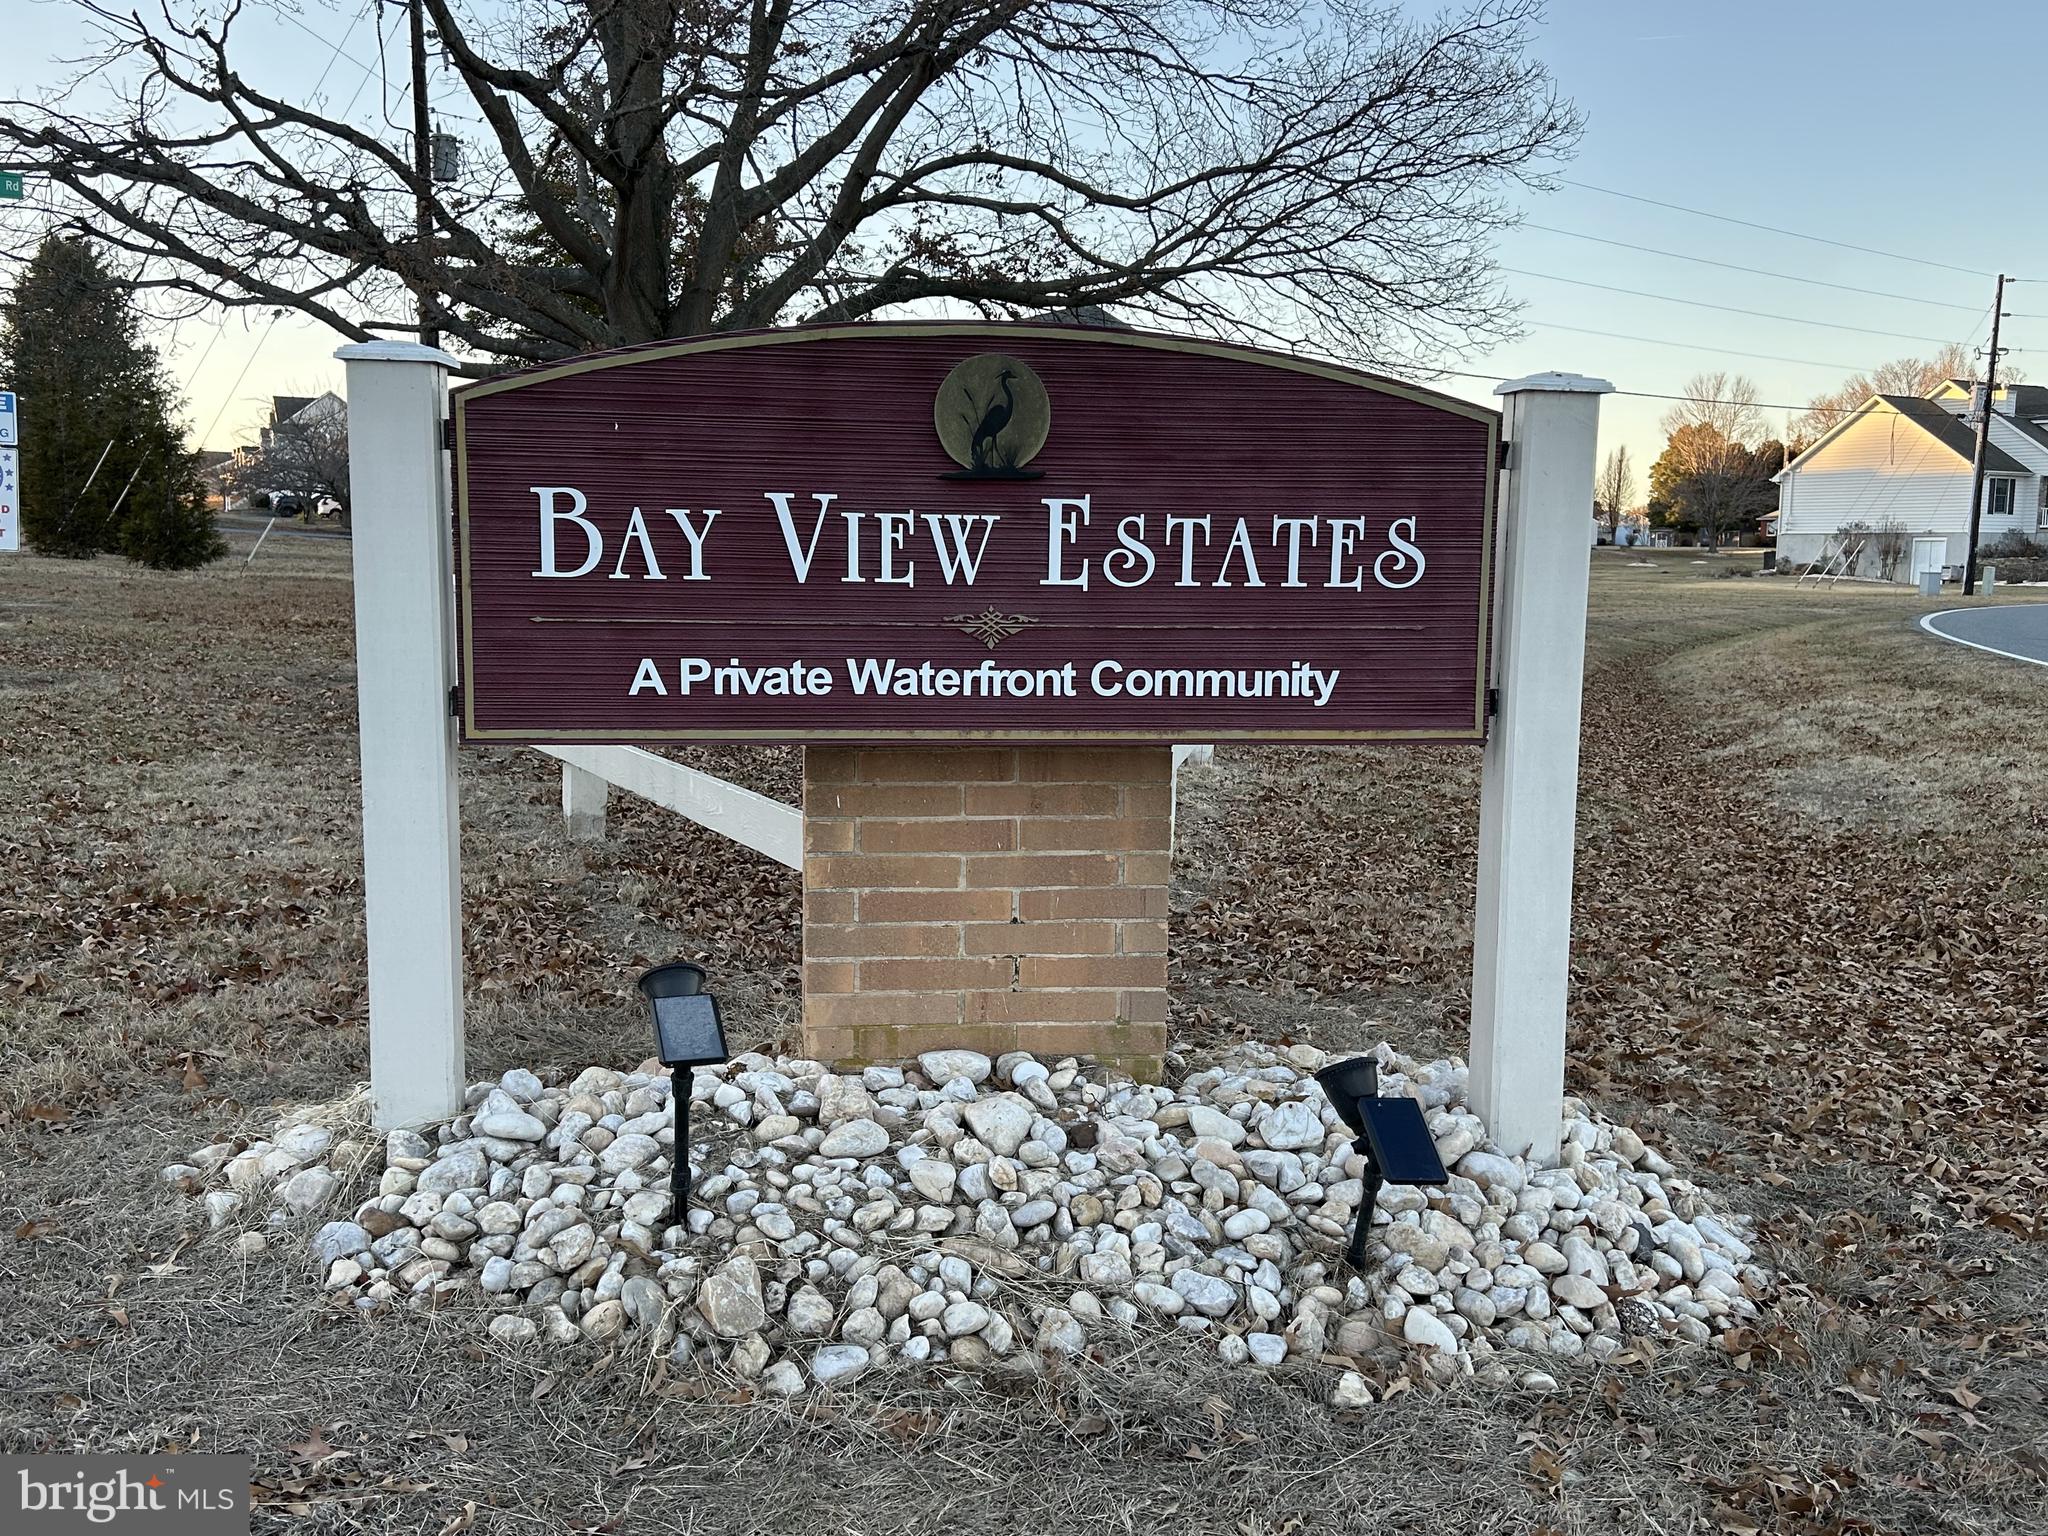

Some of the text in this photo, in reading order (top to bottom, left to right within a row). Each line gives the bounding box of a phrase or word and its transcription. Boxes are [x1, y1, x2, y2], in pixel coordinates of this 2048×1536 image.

[5, 180, 20, 192] Rd
[529, 486, 1427, 593] BAY VIEW ESTATES
[628, 658, 1341, 707] A Private Waterfront Community
